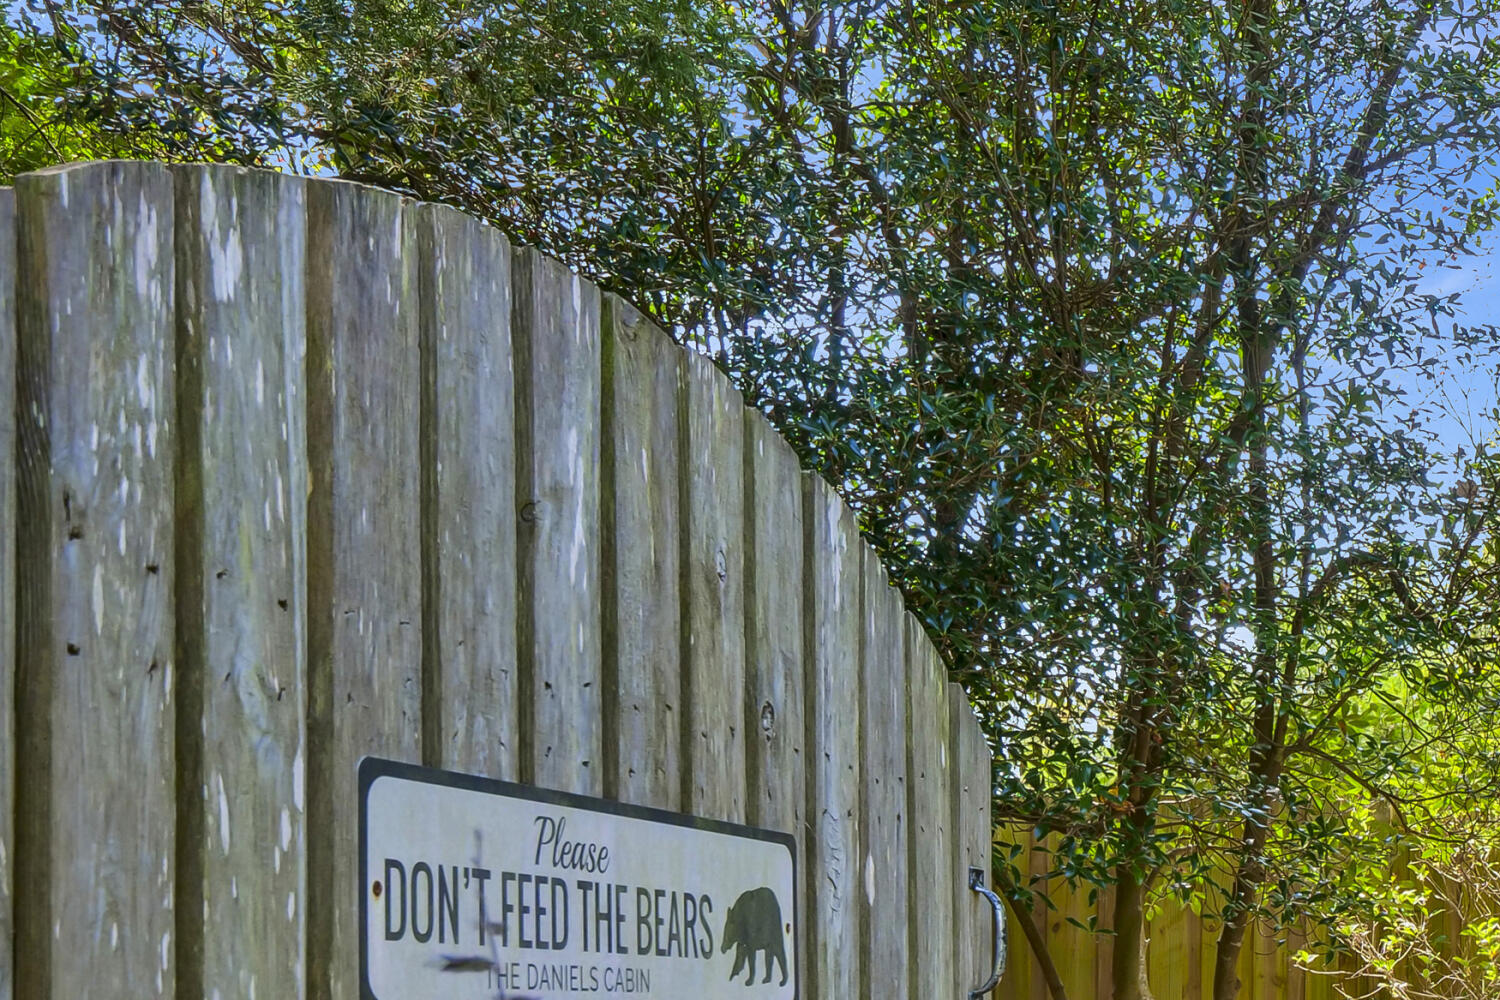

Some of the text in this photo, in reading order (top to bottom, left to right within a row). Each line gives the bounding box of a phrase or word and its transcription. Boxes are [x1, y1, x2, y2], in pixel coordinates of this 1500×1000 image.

[534, 815, 610, 874] Please
[383, 858, 714, 960] DON'T FEED THE BEARS
[527, 964, 600, 992] DANIELS
[604, 967, 651, 993] CABIN
